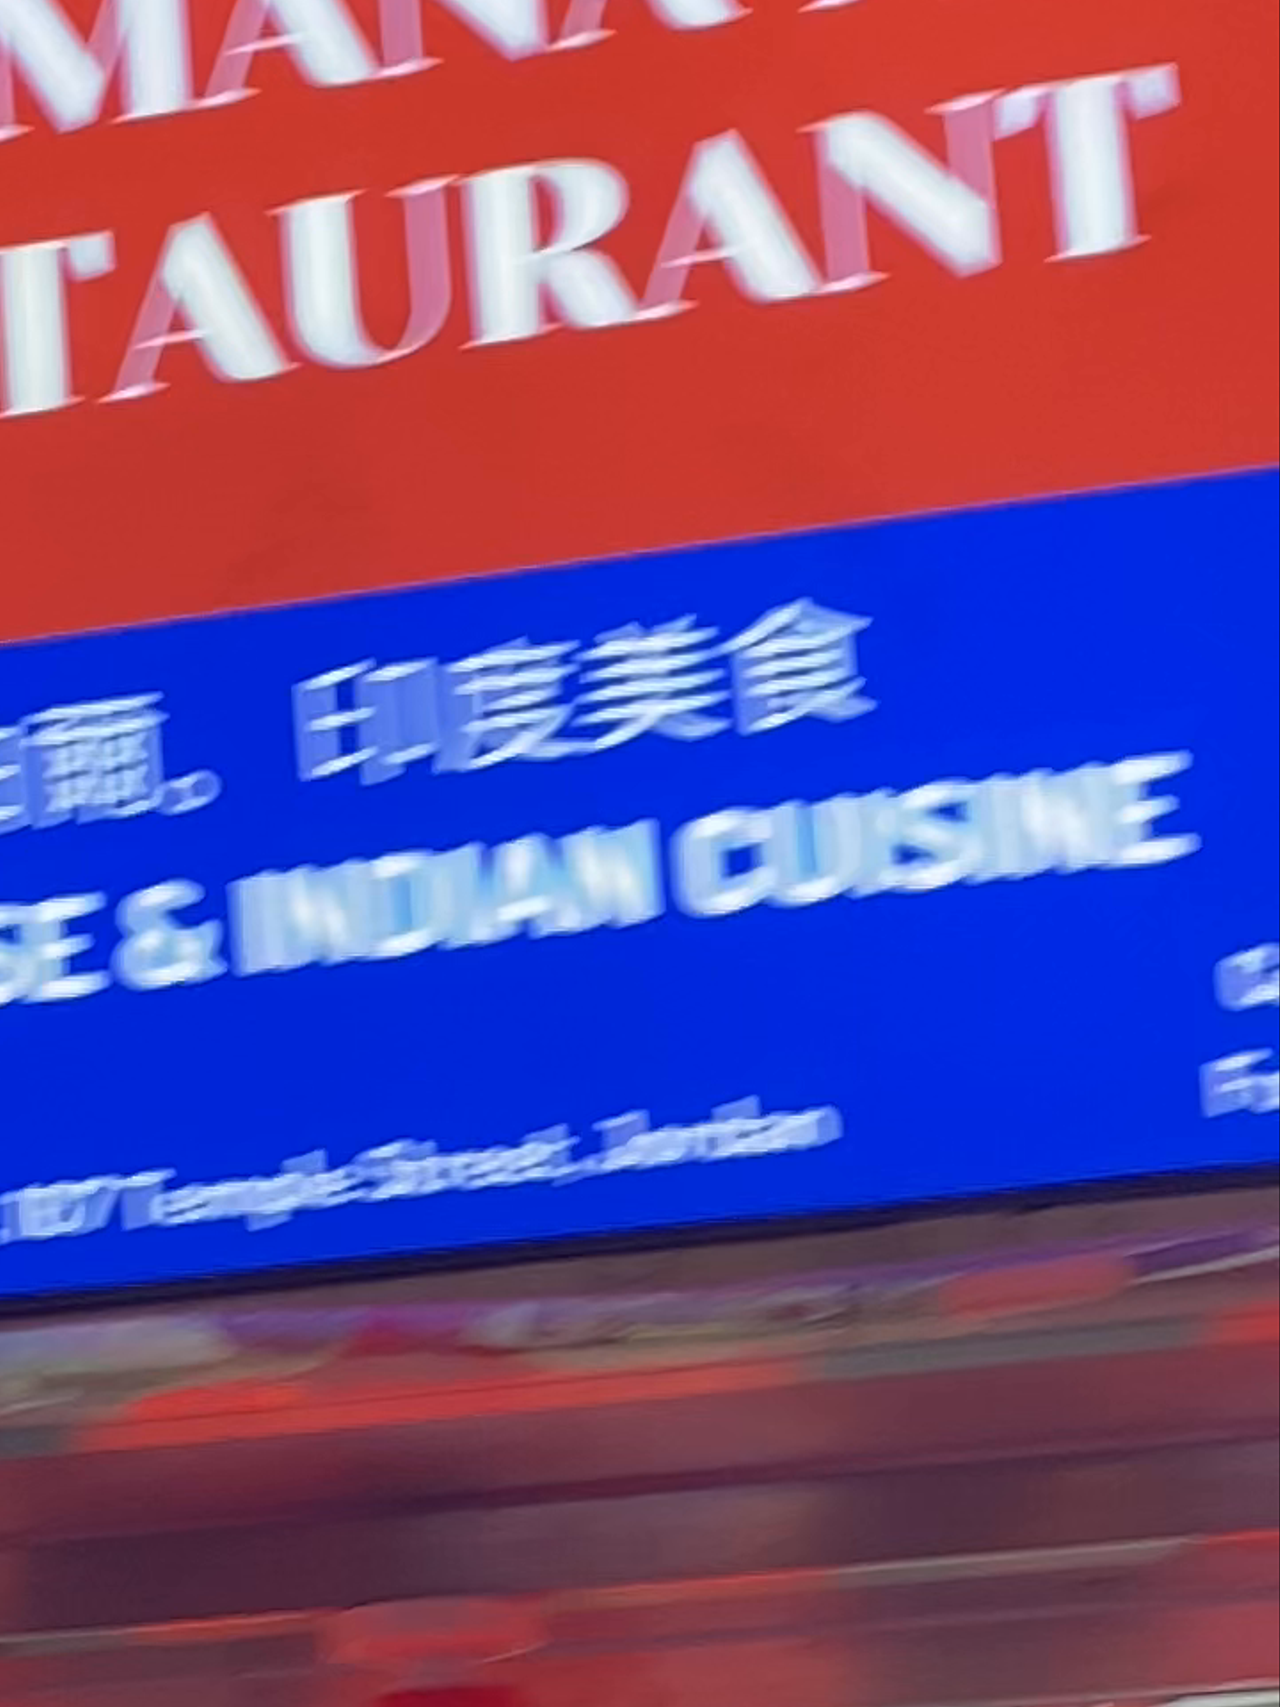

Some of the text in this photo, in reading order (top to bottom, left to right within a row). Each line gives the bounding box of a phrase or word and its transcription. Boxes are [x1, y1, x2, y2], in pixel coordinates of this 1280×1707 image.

[293, 597, 877, 786] 印度美食
[115, 879, 228, 991] &
[231, 819, 663, 977] INDIAN
[672, 751, 1200, 918] CUISINE
